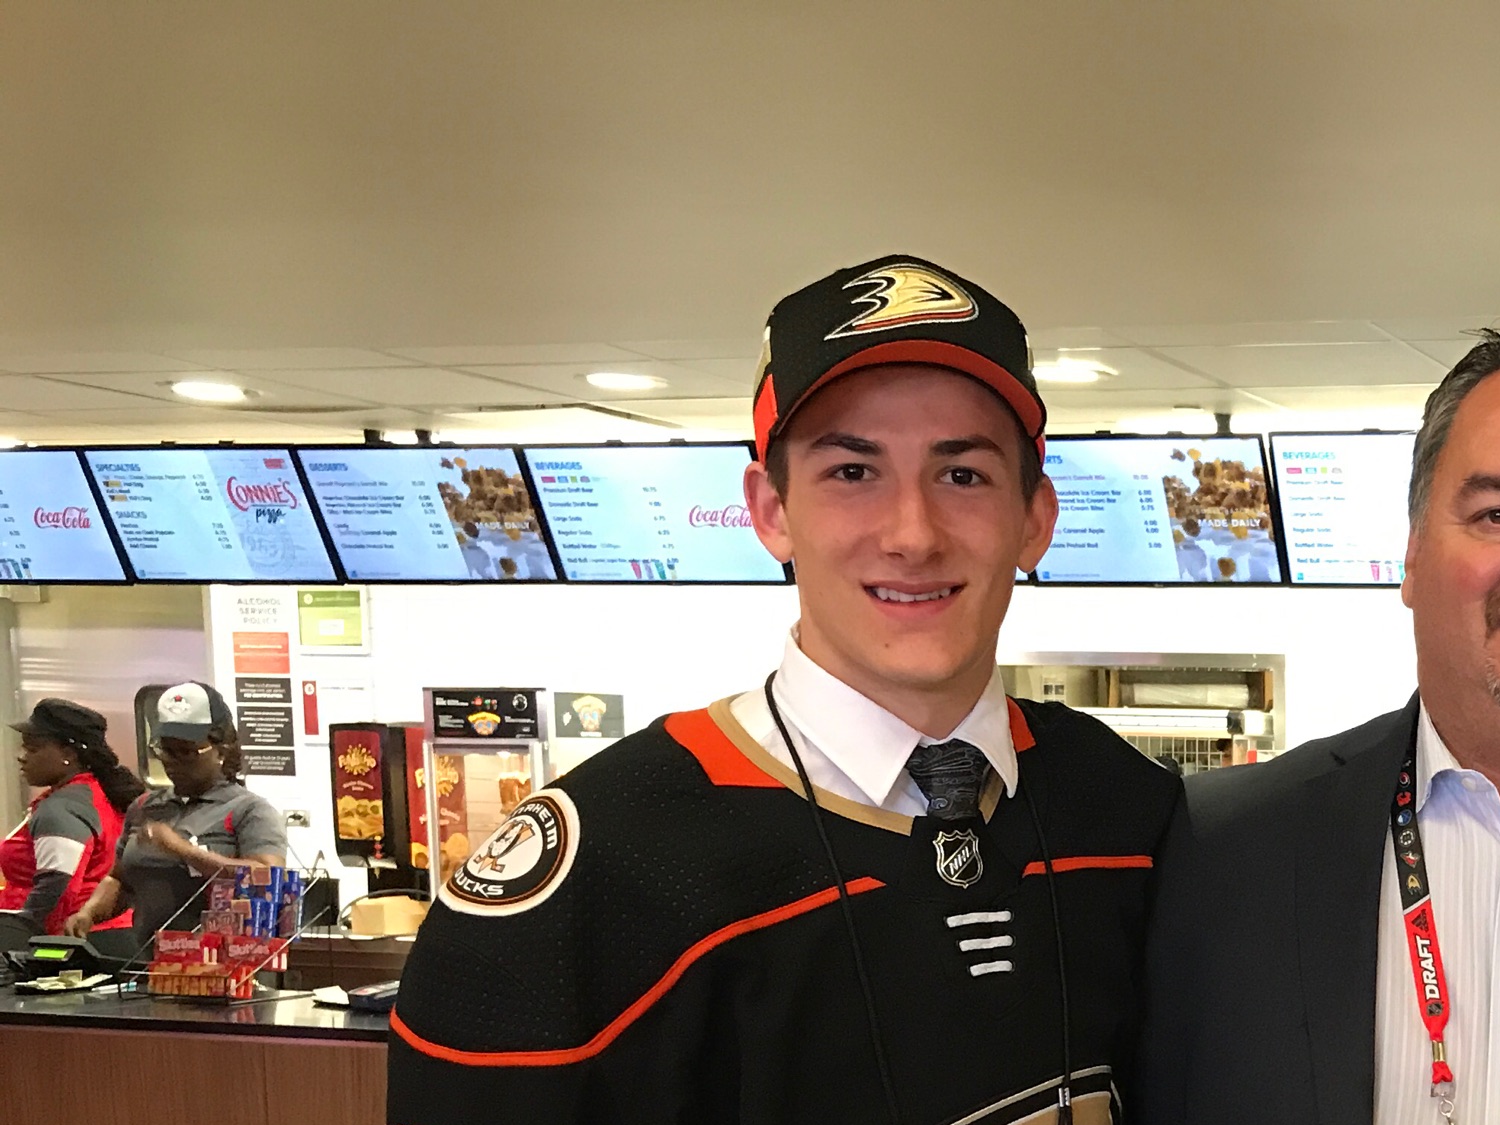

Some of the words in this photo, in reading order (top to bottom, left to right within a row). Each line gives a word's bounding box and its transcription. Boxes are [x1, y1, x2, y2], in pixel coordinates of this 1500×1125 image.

[1283, 452, 1336, 460] BEVERAGES
[535, 462, 582, 470] BEVERAGES
[34, 506, 91, 529] Coca-Cola
[256, 508, 286, 523] pizza
[1198, 519, 1228, 527] MADE
[1231, 519, 1260, 527] DAILY
[237, 598, 281, 606] ALCOHOL
[239, 607, 277, 615] SERVICE
[243, 617, 278, 625] POLICY
[513, 803, 558, 851] NAHEIM
[949, 845, 972, 875] NHL
[1416, 933, 1440, 1000] DRAFT
